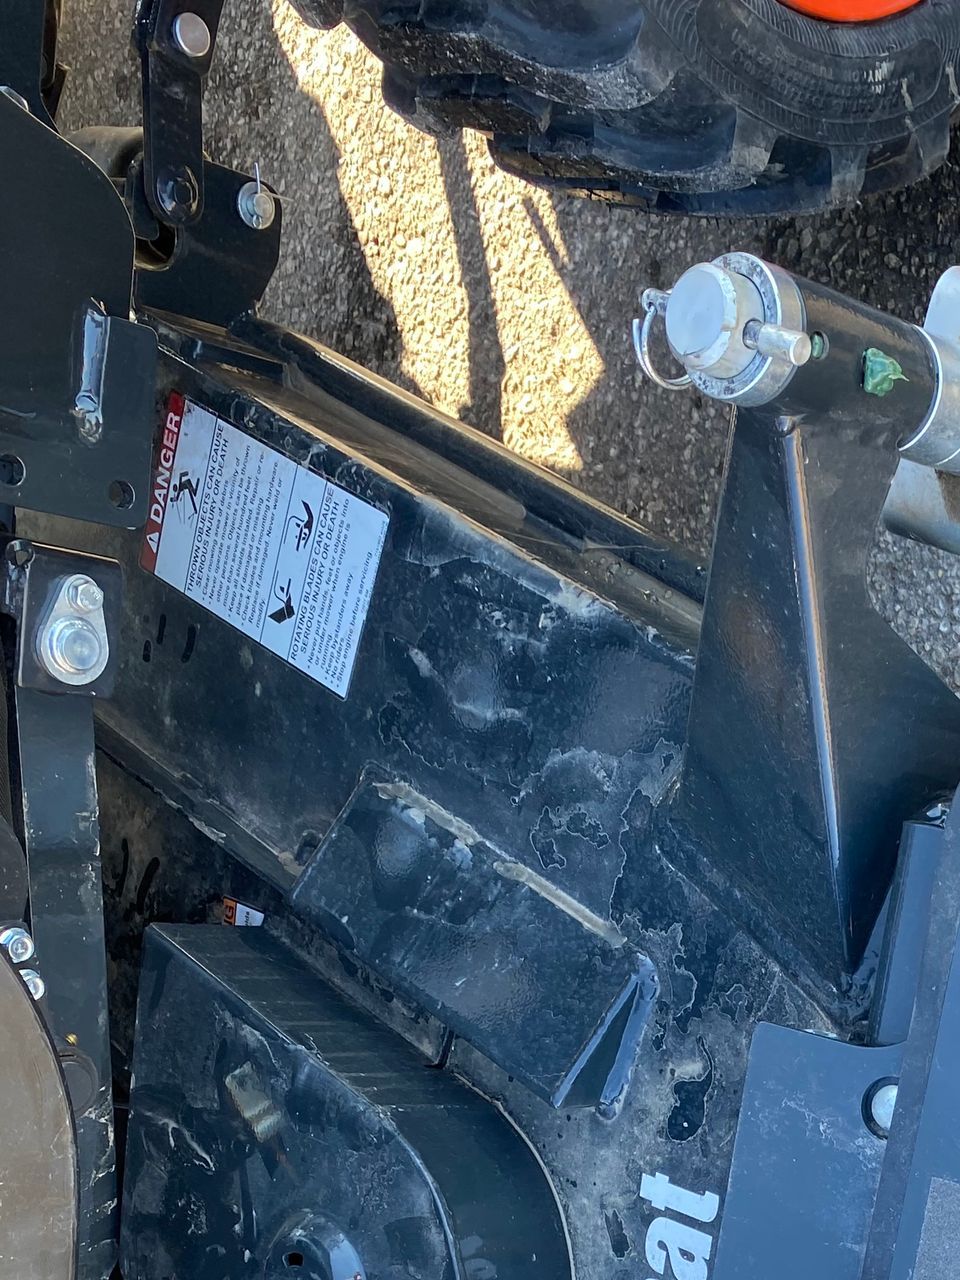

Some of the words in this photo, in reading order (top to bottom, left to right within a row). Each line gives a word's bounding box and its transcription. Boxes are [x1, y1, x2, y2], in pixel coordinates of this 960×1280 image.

[210, 422, 224, 464] CAUSE
[215, 437, 229, 477] DEATH
[148, 409, 182, 525] DANGER
[205, 464, 216, 491] CAN
[211, 477, 221, 497] OR
[195, 491, 211, 544] OBJECTS
[203, 495, 218, 538] INJURY
[318, 485, 335, 529] CAUSE
[324, 500, 340, 541] DEATH
[194, 538, 210, 588] SERIOUS
[312, 528, 325, 556] CAN
[320, 540, 330, 561] OR
[185, 543, 201, 593] THROWN
[302, 556, 319, 604] BLADES
[310, 560, 326, 603] INJURY
[289, 603, 308, 661] ROTATING
[298, 602, 317, 655] SERIOUS
